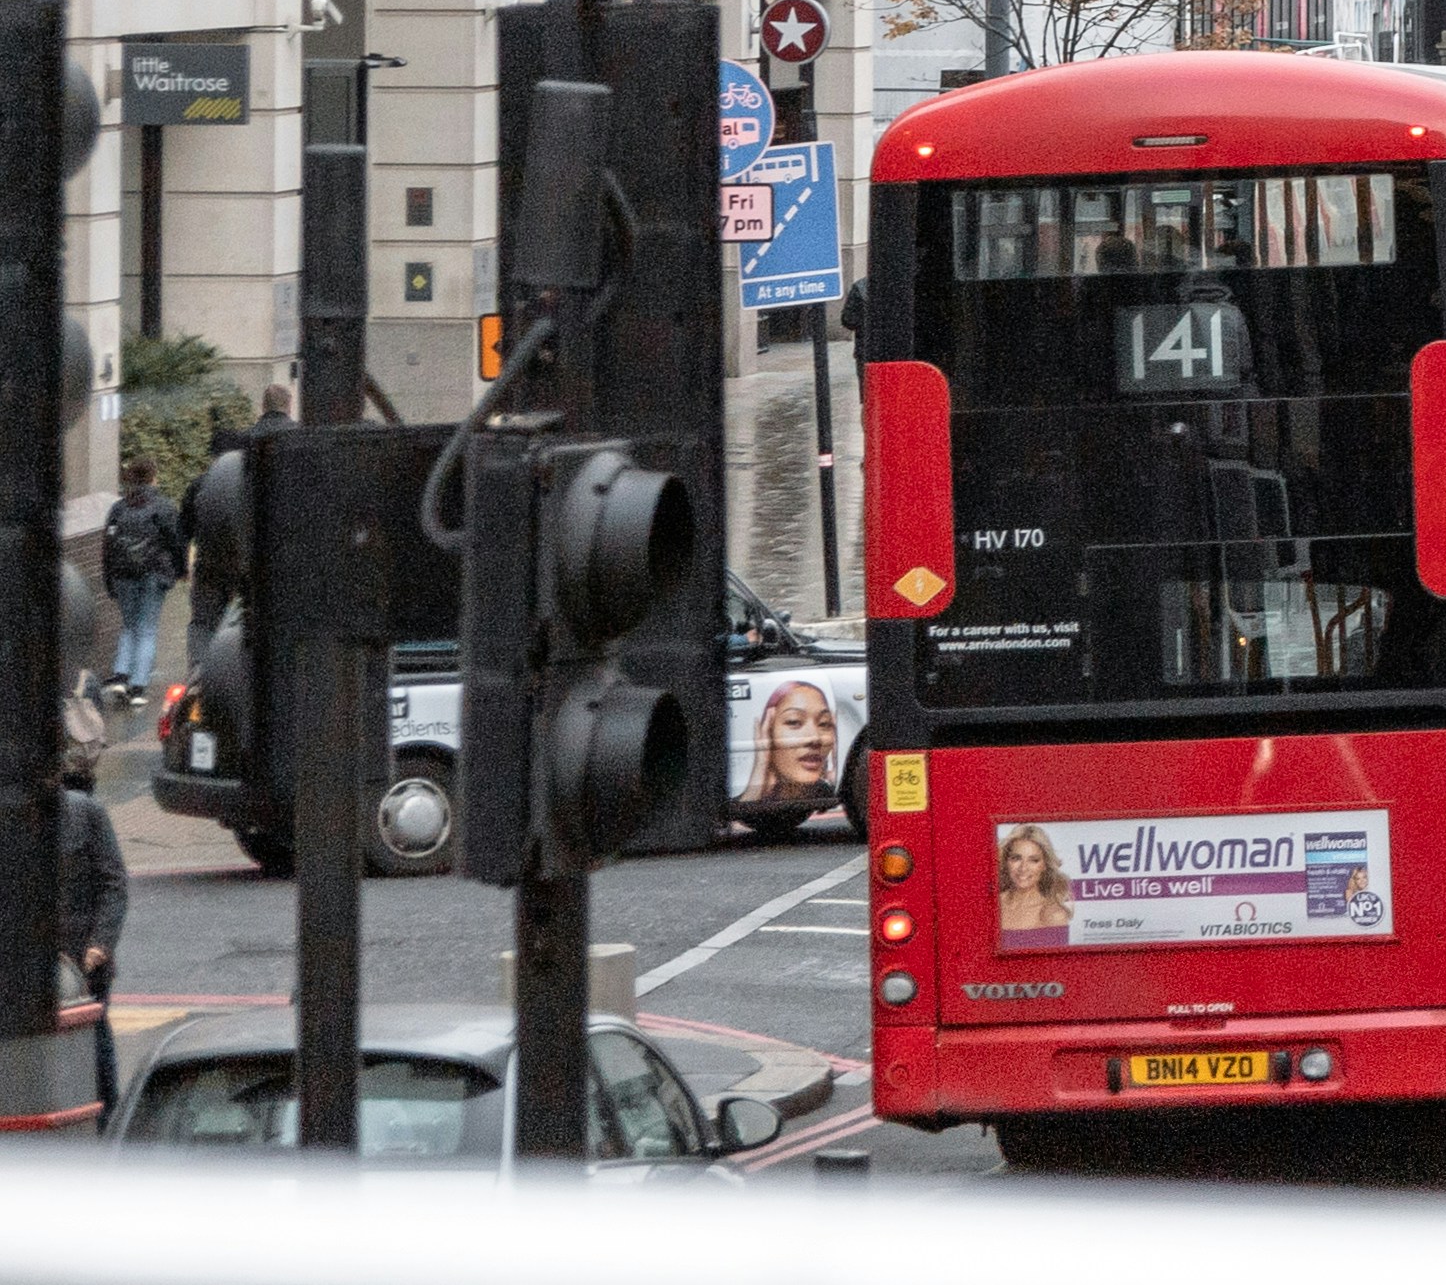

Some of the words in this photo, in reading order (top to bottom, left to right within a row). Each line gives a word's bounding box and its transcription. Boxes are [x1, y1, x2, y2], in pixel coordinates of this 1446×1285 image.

[132, 57, 169, 73] little
[133, 73, 229, 92] Waitrose
[728, 193, 754, 211] Fri
[757, 285, 772, 300] At
[775, 283, 796, 300] any
[798, 280, 825, 296] time
[1131, 308, 1224, 379] 141
[974, 530, 1006, 550] HV
[1014, 528, 1045, 548] 170
[928, 626, 948, 637] For
[950, 627, 960, 636] a
[962, 625, 1002, 636] career
[1004, 622, 1031, 635] with
[1052, 621, 1080, 633] visit
[938, 636, 1071, 651] www.arrivalondon.com
[1078, 826, 1295, 874] wellwoman
[1305, 835, 1367, 850] wellwoman
[1081, 879, 1124, 898] Live
[1131, 877, 1161, 897] life
[1169, 876, 1213, 895] well
[1083, 917, 1113, 929] Tess
[1115, 917, 1144, 930] Daly
[1200, 920, 1292, 937] VITABIOTICS
[960, 981, 1065, 1000] VOLVO
[1167, 1004, 1192, 1014] PULL
[1192, 1004, 1206, 1013] TO
[1206, 1002, 1235, 1013] OPEN
[1146, 1057, 1199, 1081] BN14
[1207, 1056, 1253, 1079] VZO
